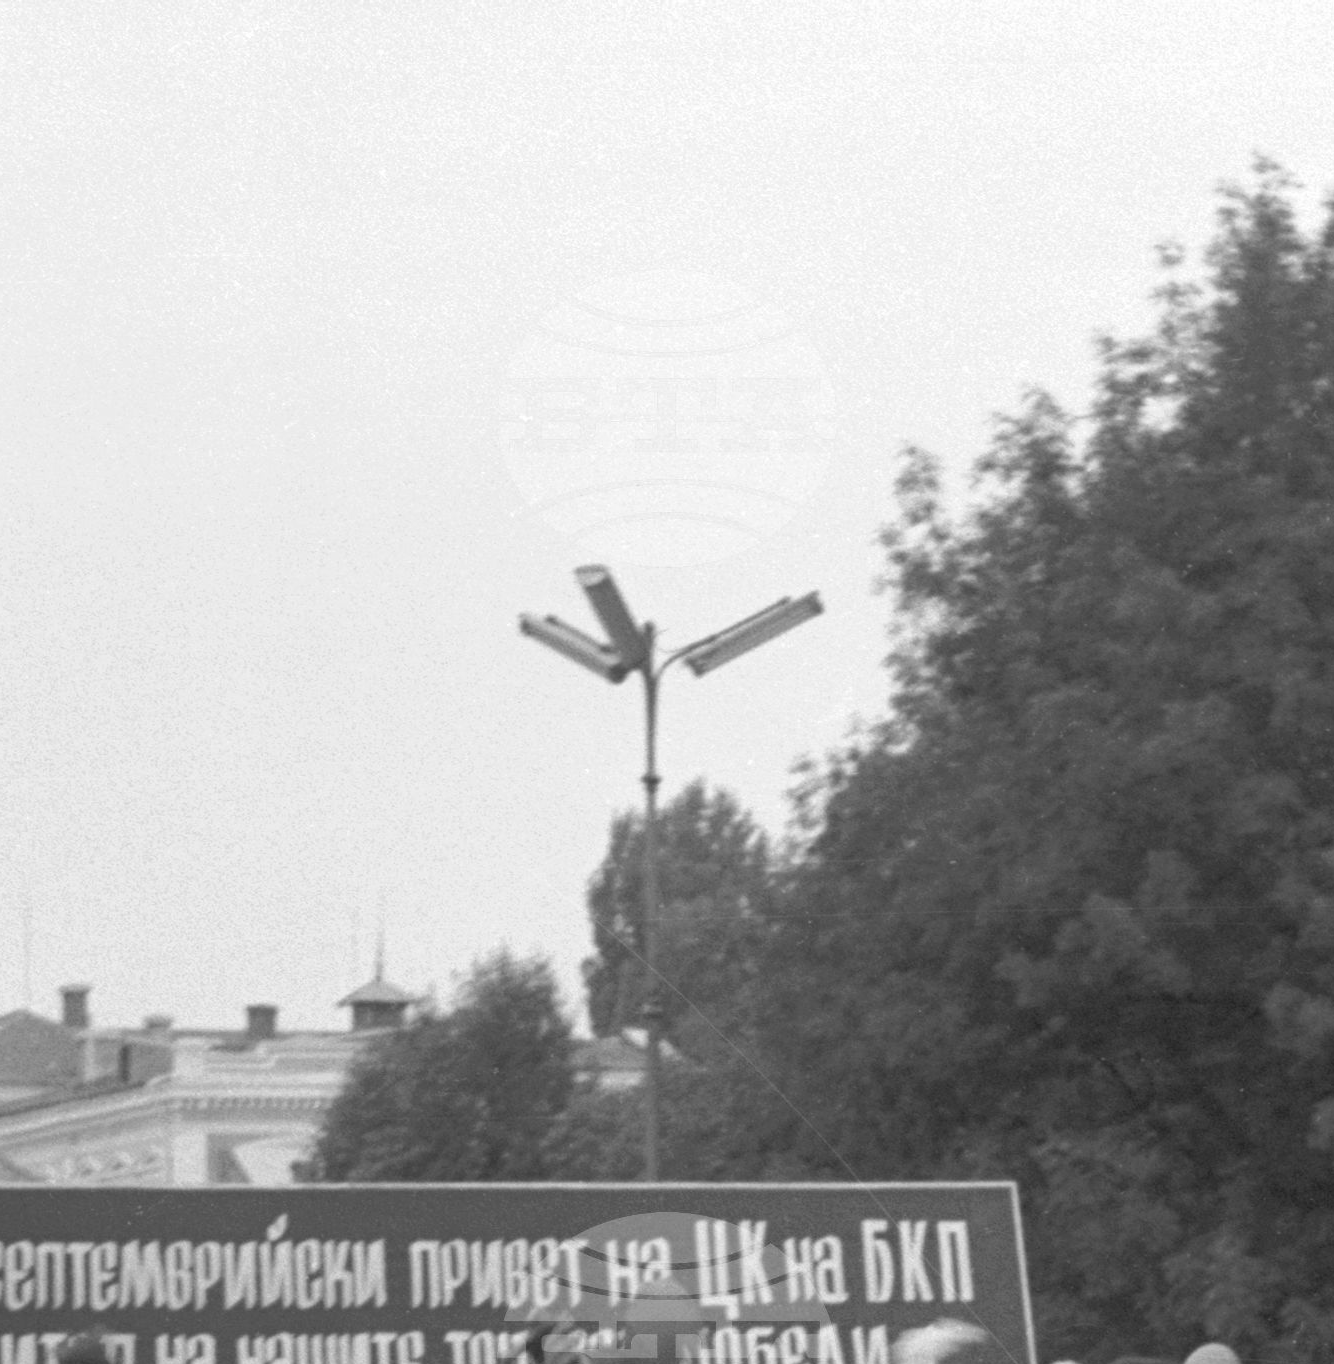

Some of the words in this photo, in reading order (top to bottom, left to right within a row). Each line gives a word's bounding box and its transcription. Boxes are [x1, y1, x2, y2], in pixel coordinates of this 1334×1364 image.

[409, 1237, 589, 1310] привет
[606, 1236, 671, 1308] на
[694, 1218, 774, 1321] ЦК
[783, 1234, 849, 1305] на
[860, 1217, 975, 1304] БКП
